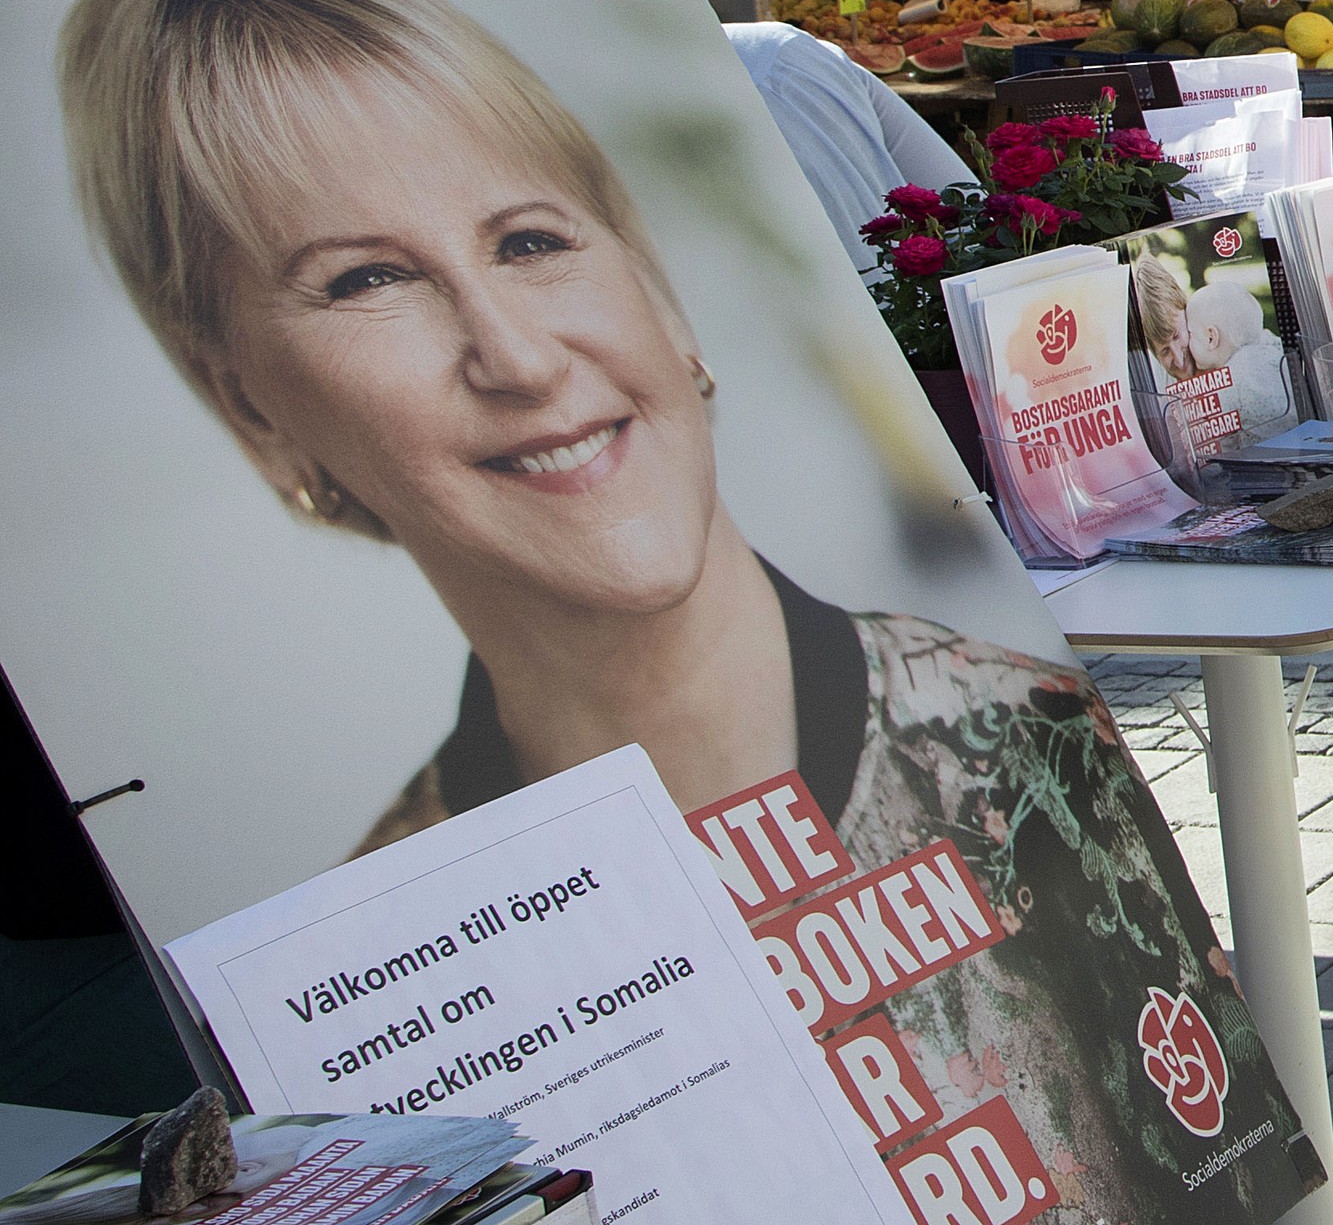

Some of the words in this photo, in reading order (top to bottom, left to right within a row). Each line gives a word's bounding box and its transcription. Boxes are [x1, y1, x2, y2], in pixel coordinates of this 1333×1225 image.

[1182, 91, 1199, 102] BRA
[1200, 87, 1240, 101] STADSDEL
[1240, 86, 1254, 97] ATT
[1255, 85, 1268, 95] BO
[1179, 152, 1195, 163] BRA
[1196, 147, 1232, 162] STADSDEL
[1232, 144, 1244, 154] ATT
[1245, 142, 1257, 152] BO
[1011, 379, 1122, 434] BOSTADSGARANTI
[1032, 365, 1092, 389] Socialdemokraterna
[1177, 367, 1232, 400] STARKARE
[1017, 426, 1069, 475] FÖR
[1063, 404, 1132, 458] UNGA
[702, 784, 839, 907] NTE
[286, 933, 459, 1024] Välkomna
[459, 903, 507, 945] till
[507, 866, 601, 922] öppet
[321, 1005, 436, 1082] samtal
[440, 984, 496, 1025] om
[369, 1022, 559, 1115] tvecklingen
[557, 1007, 576, 1035] i
[576, 954, 695, 1026] Somalia
[544, 1065, 590, 1095] Sveriges
[590, 1026, 666, 1072] utrikesminister
[532, 1153, 556, 1169] rhia
[555, 1131, 600, 1157] Mumin,
[599, 1084, 683, 1135] riksdagsledamot
[687, 1058, 731, 1086] Somalias
[817, 1036, 926, 1144] R
[243, 1177, 289, 1207] SIDA
[277, 1141, 359, 1184] MAANTA
[331, 1166, 387, 1199] SIDAN
[898, 1125, 1046, 1225] RD.
[1182, 1119, 1275, 1192] Socialdemokraterna
[601, 1188, 660, 1225] gskandidat
